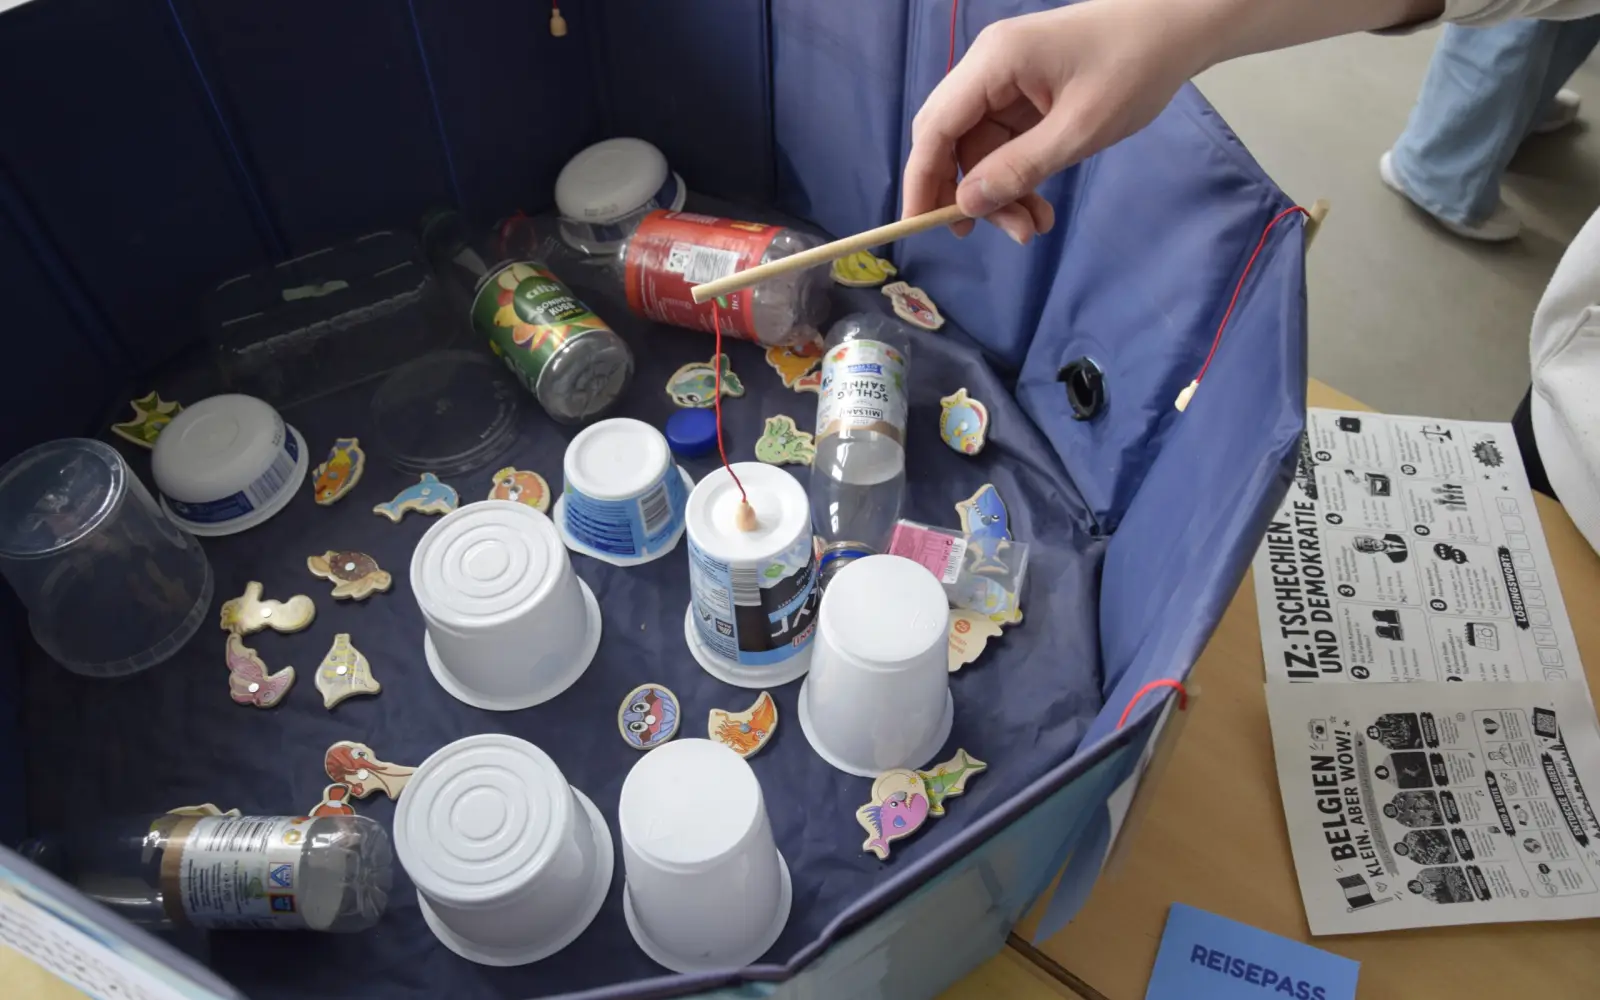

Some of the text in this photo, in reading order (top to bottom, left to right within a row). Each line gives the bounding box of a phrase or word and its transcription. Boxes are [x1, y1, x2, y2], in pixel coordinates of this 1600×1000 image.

[1267, 522, 1309, 639] TSCHECHIEN
[1293, 500, 1334, 623] DEMOKRATIE
[1499, 553, 1527, 621] LÖSUNGSWORT:
[1314, 629, 1343, 673] UND
[1334, 730, 1357, 782] WOW!
[1310, 755, 1357, 862] BELGIEN
[1344, 786, 1366, 826] ABER
[1499, 813, 1512, 830] LAND
[1543, 761, 1583, 835] ENTDECKE BELGIEN!
[1356, 829, 1384, 878] KLEIN,
[1189, 944, 1326, 1000] REISEPASS
